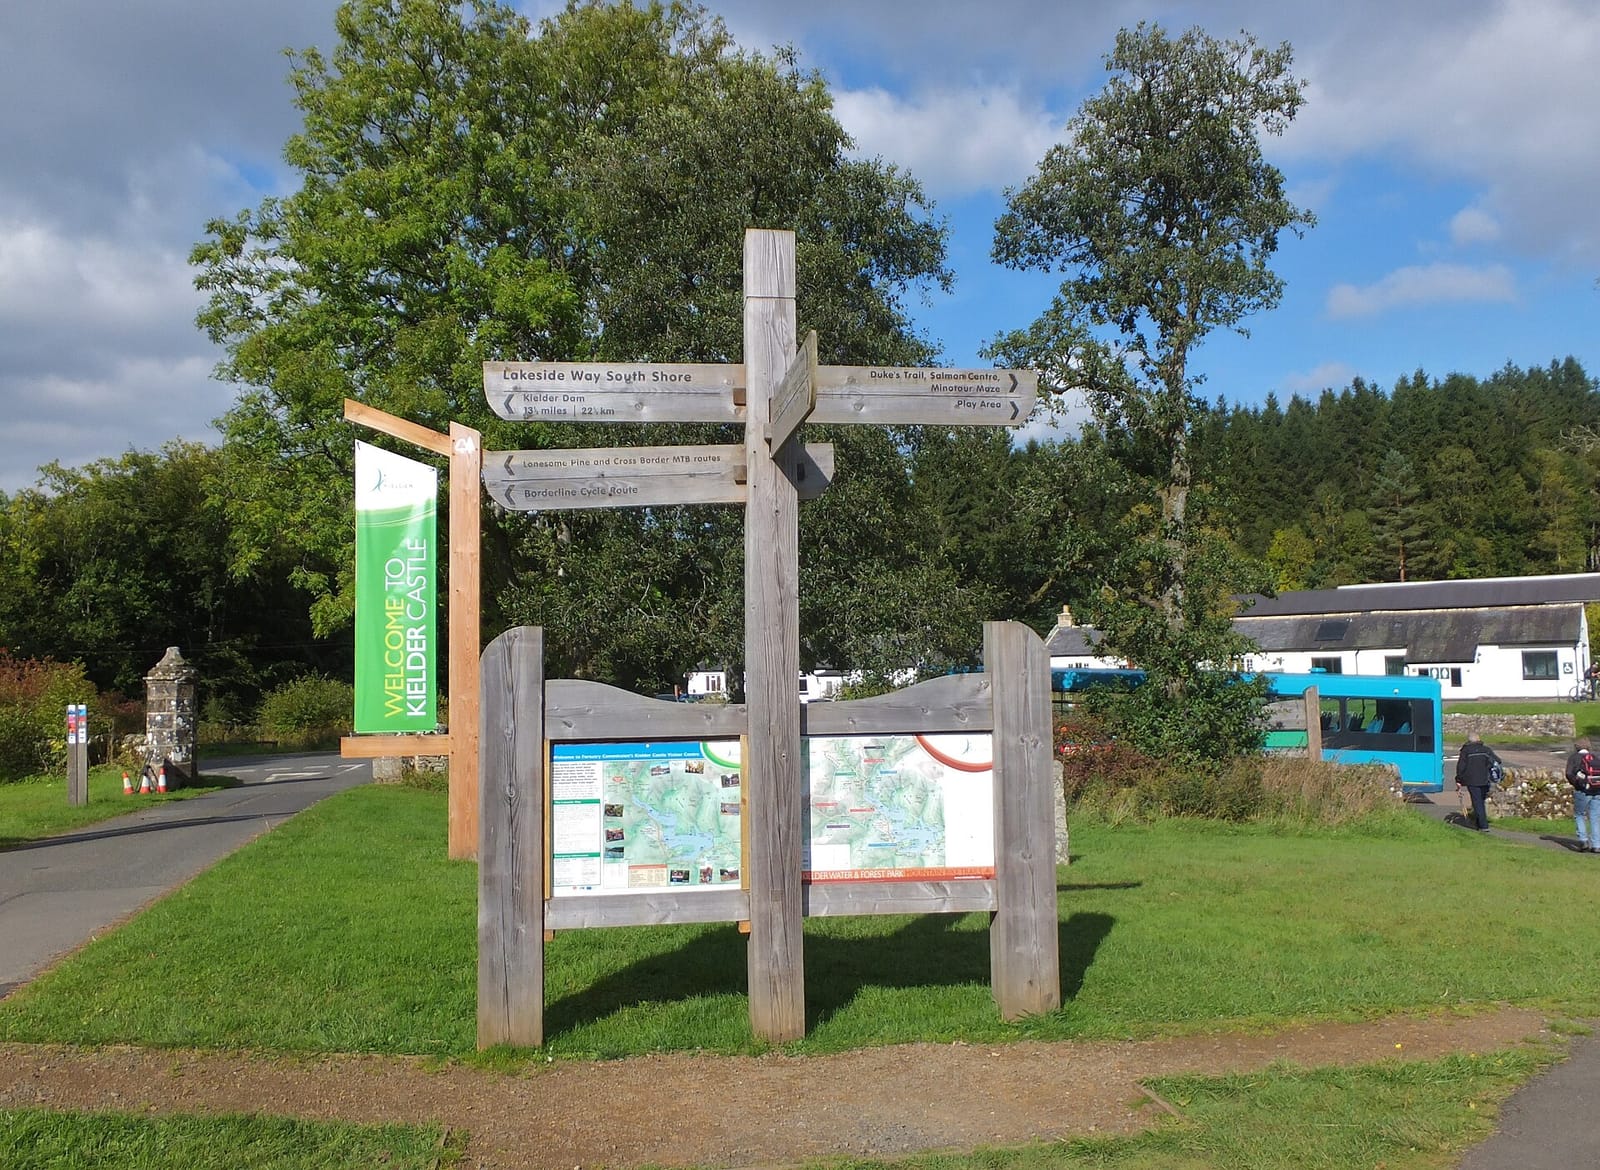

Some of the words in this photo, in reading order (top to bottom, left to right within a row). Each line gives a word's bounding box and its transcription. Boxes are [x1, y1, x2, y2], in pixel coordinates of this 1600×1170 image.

[503, 369, 565, 380] Lakeside
[571, 370, 600, 383] Way
[606, 371, 646, 382] South
[652, 371, 692, 382] Shore
[870, 370, 900, 379] Duke's
[903, 371, 927, 381] Trail,
[930, 372, 967, 380] Salmon
[968, 373, 1001, 382] Centre,
[976, 385, 1000, 393] Maze
[523, 394, 559, 402] Kielder
[562, 394, 585, 402] Dam
[957, 400, 977, 409] Play
[541, 407, 567, 415] miles
[600, 407, 615, 415] km
[523, 460, 567, 468] Lonesome
[593, 458, 610, 466] and
[613, 457, 637, 465] Cross
[640, 456, 669, 464] Border
[672, 455, 691, 463] MTB
[524, 488, 577, 498] Borderline
[580, 487, 606, 498] Cycle
[610, 486, 638, 495] Route
[385, 557, 405, 591] TO
[406, 538, 427, 621] CASTLE
[385, 598, 405, 718] WELCOME
[406, 624, 427, 717] KIELDER
[829, 870, 854, 880] WATER
[860, 869, 885, 879] FOREST
[887, 869, 904, 878] PARK
